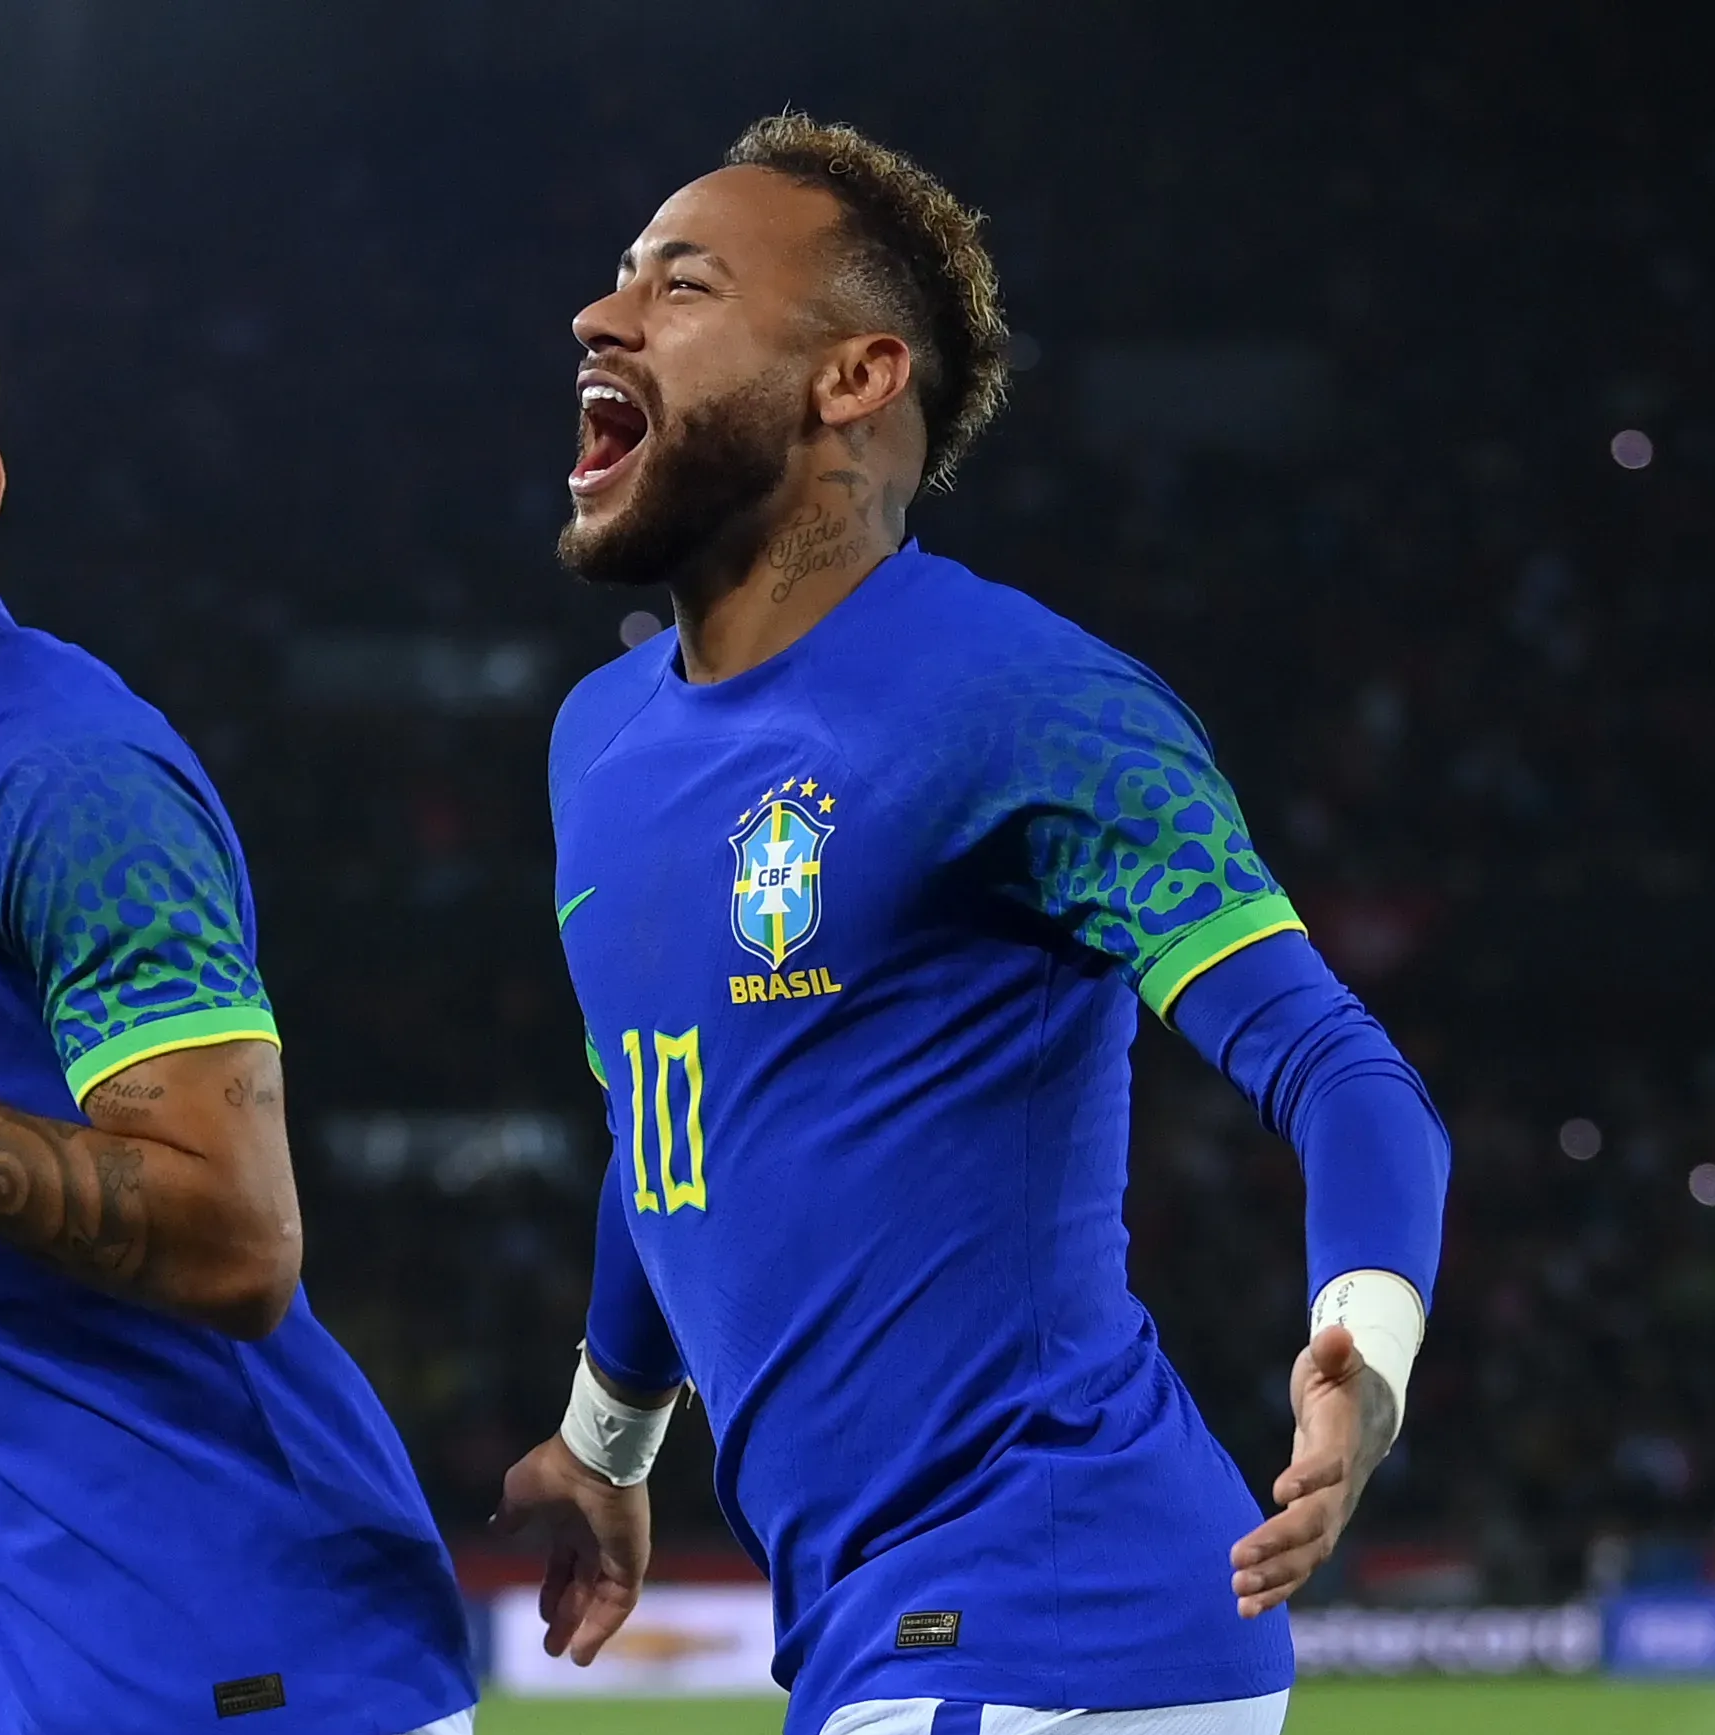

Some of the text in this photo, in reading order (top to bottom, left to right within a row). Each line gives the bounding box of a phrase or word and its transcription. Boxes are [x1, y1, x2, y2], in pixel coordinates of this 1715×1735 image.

[758, 867, 792, 887] CBF
[728, 967, 843, 1004] BRASIL
[622, 1024, 707, 1216] 10
